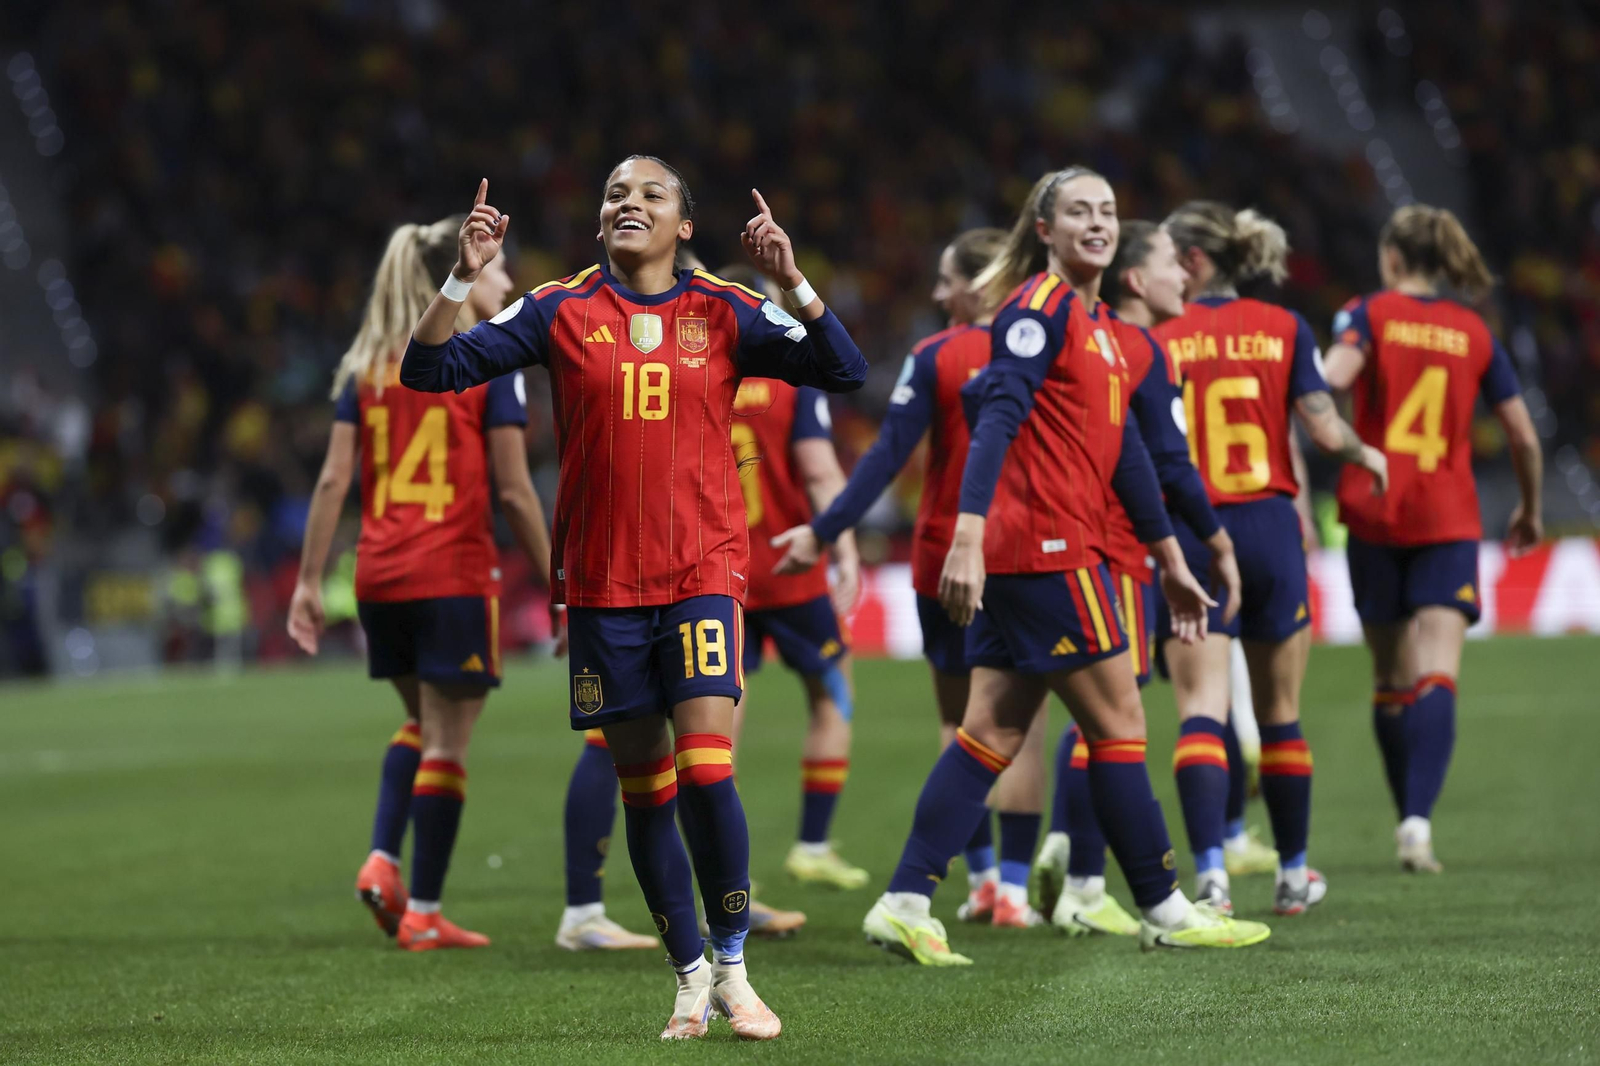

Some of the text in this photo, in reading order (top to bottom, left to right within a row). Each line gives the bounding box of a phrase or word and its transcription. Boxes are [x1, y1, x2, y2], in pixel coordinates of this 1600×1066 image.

[1225, 330, 1284, 362] LEÓN
[620, 362, 670, 420] 18
[1386, 366, 1449, 472] 4
[366, 405, 455, 522] 14
[679, 619, 728, 679] 18
